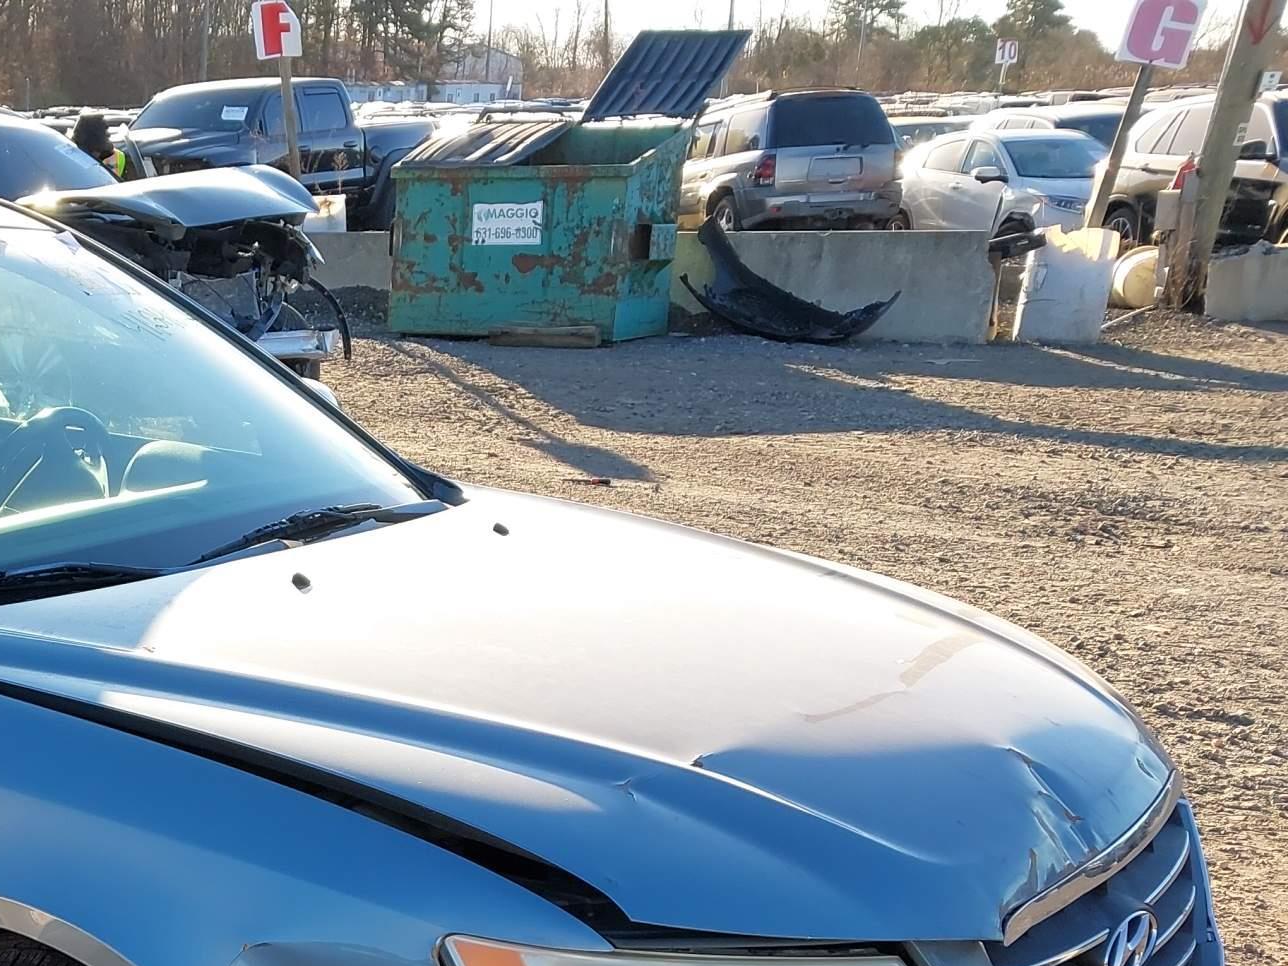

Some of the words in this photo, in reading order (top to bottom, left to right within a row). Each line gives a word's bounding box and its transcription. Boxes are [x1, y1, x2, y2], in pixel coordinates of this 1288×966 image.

[260, 2, 290, 56] F
[1127, 0, 1199, 64] G
[999, 39, 1017, 60] 10
[487, 207, 539, 219] MAGGIO
